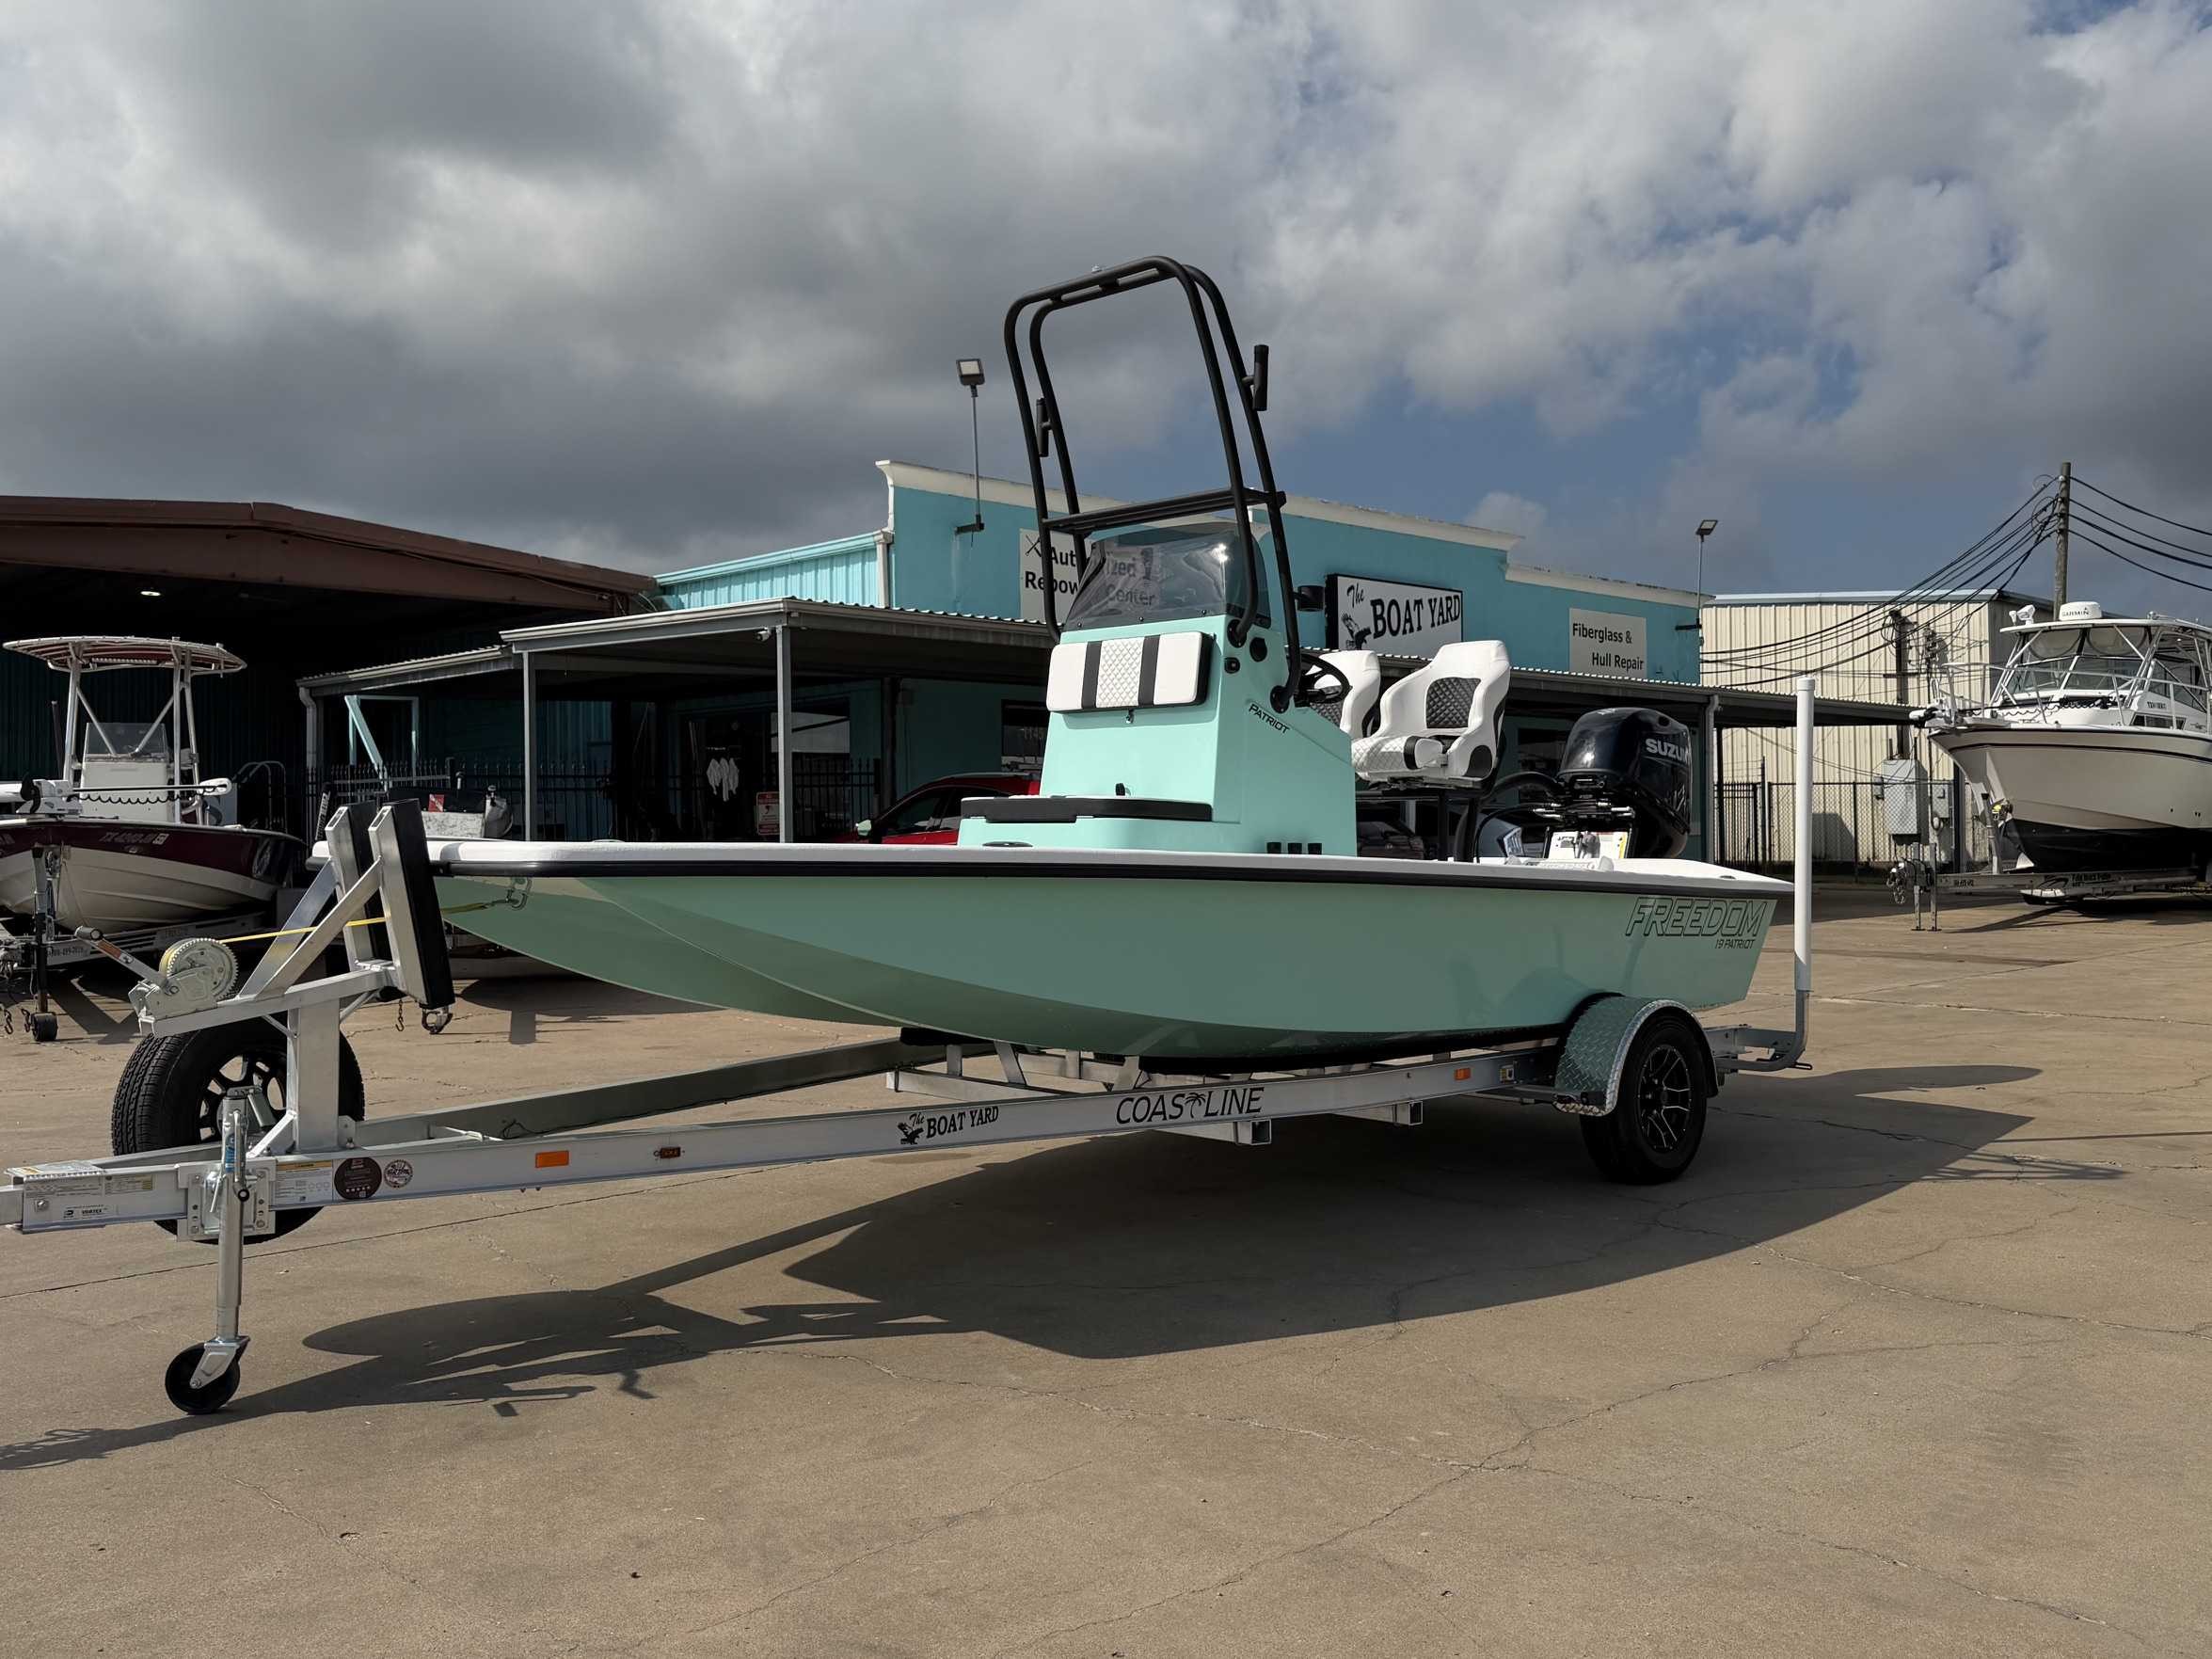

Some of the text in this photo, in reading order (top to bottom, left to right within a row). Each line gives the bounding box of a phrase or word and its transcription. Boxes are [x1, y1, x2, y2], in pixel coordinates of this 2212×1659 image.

[1346, 582, 1364, 609] The
[1370, 594, 1461, 640] BOAT YARD
[1572, 622, 1632, 644] Fiberglass &
[1592, 651, 1645, 673] Hull Repair
[1249, 703, 1291, 734] PATRIOT
[1625, 896, 1768, 937] FREEDOM
[1725, 939, 1756, 949] PATRIOT
[909, 1111, 925, 1126] The
[926, 1106, 999, 1139] BOAT YARD
